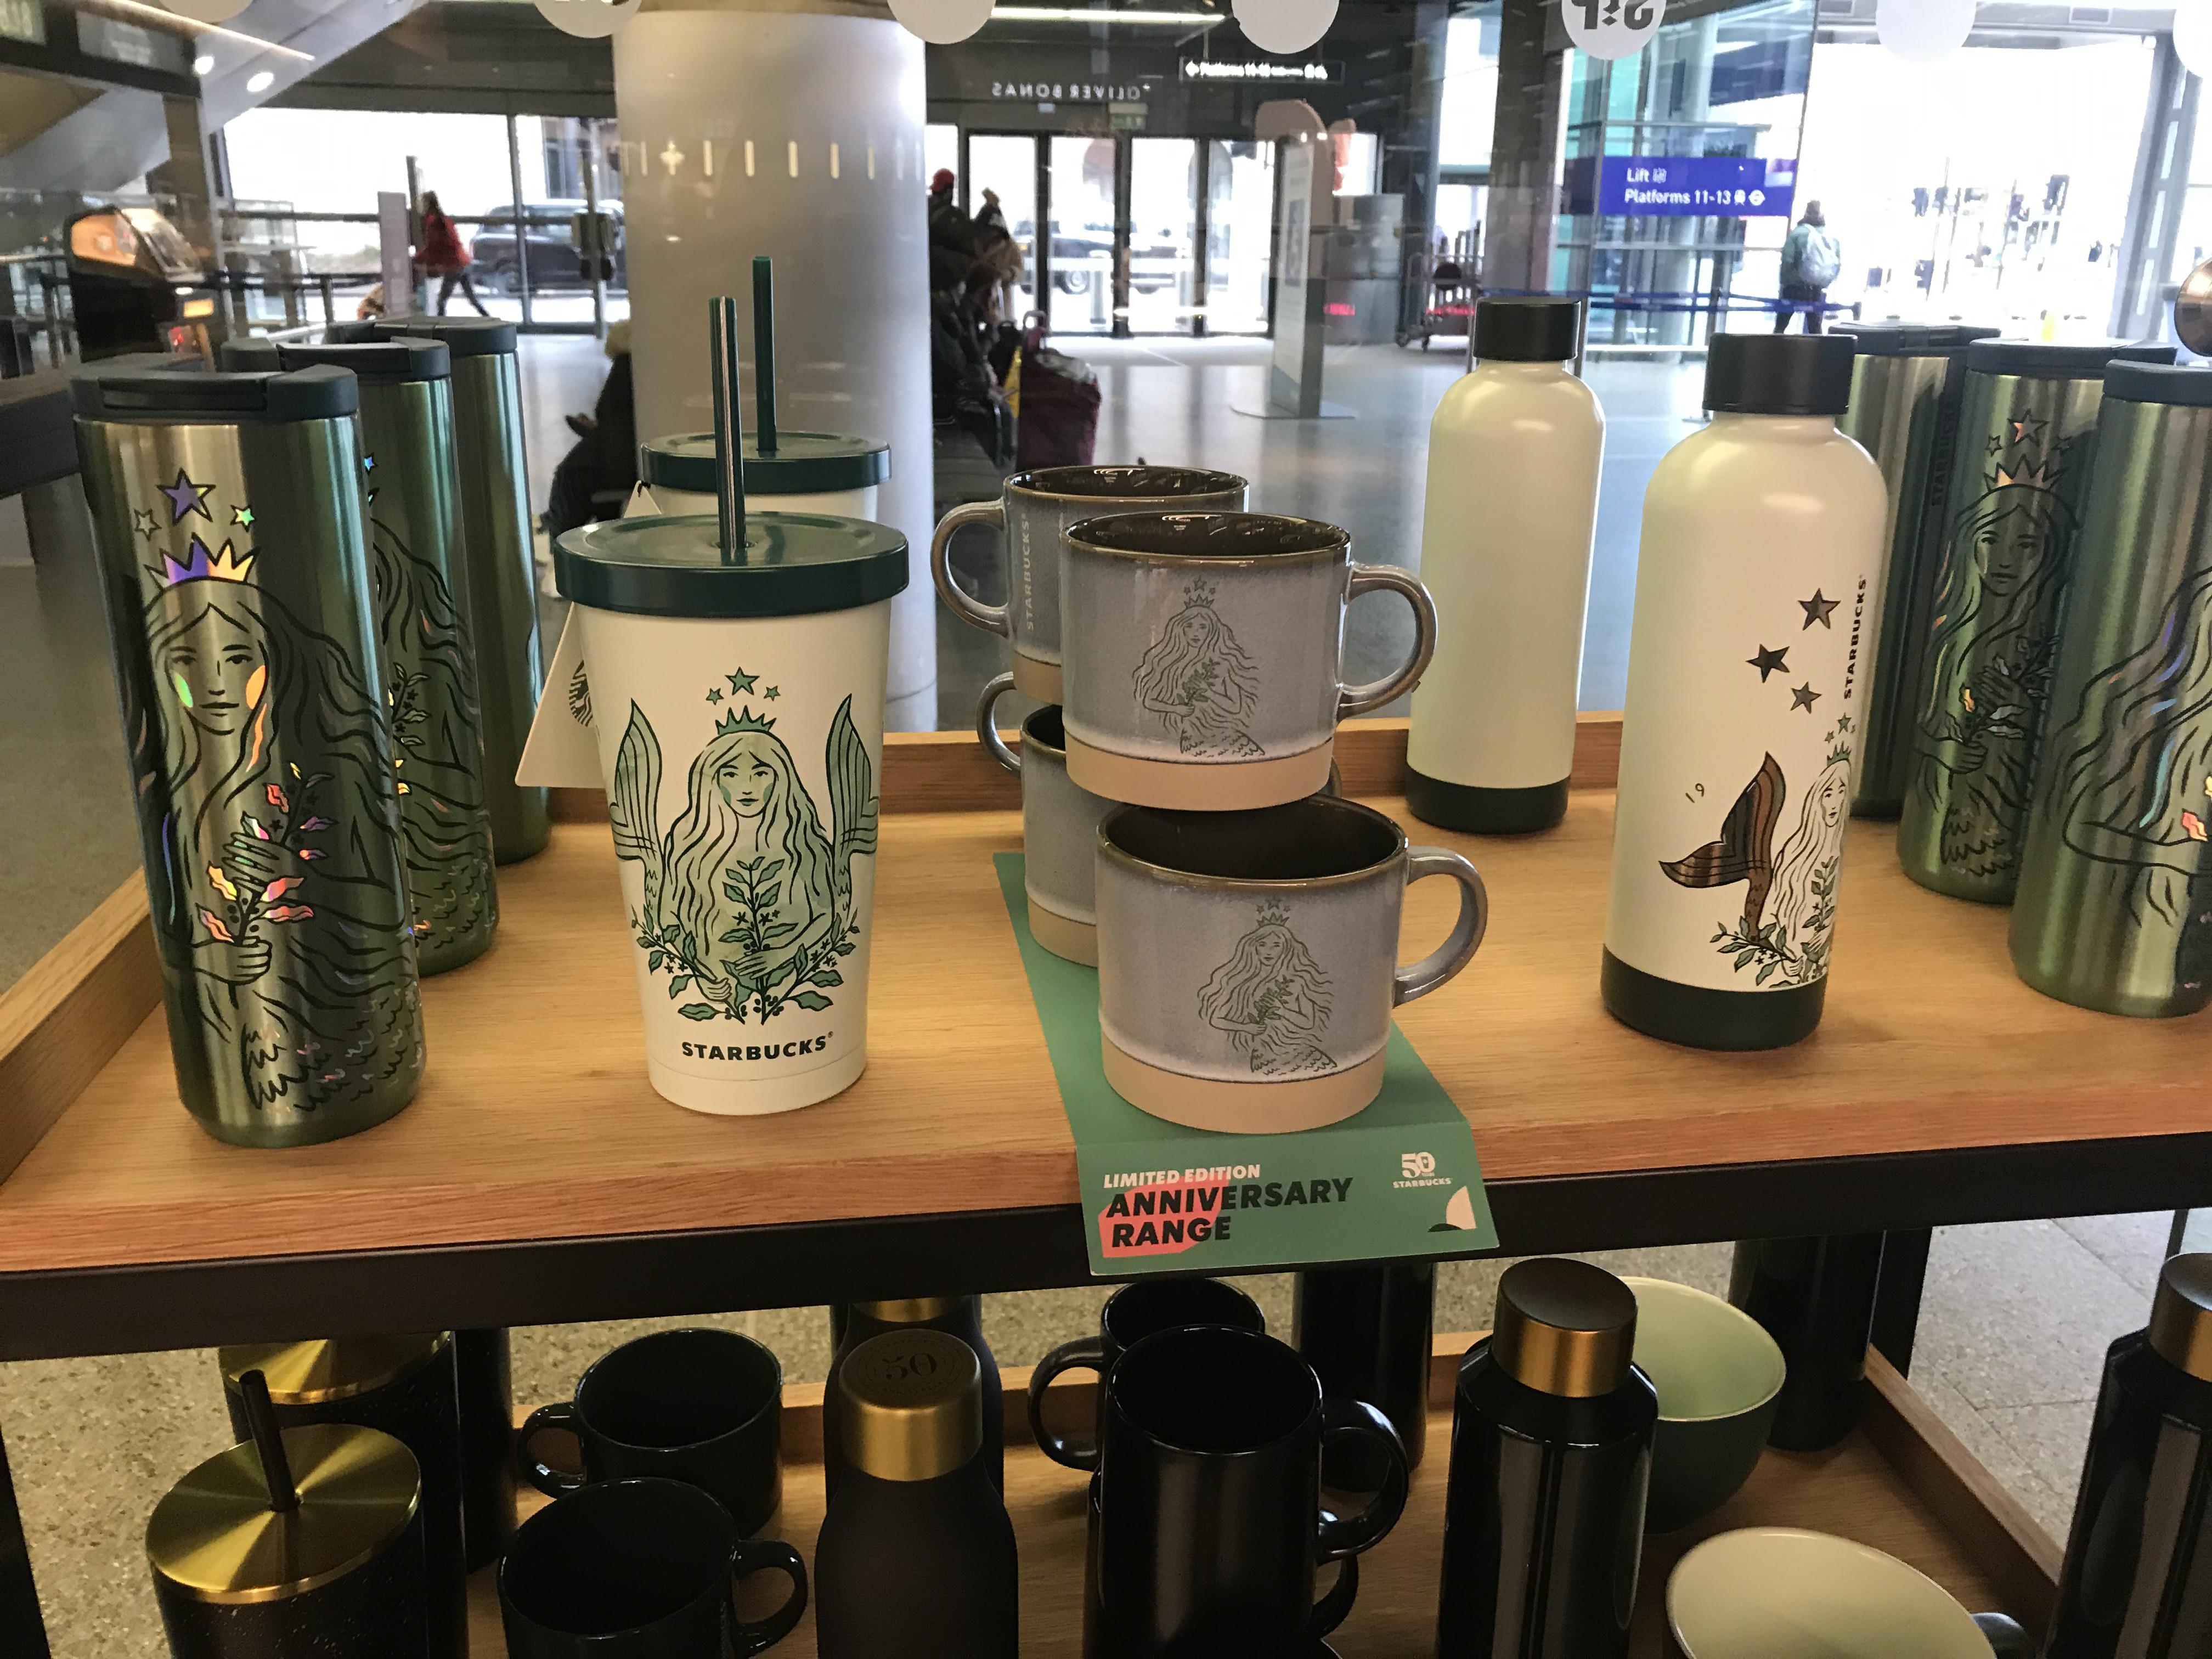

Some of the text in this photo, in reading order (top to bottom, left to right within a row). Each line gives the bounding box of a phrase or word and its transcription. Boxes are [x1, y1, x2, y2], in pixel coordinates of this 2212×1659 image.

[1627, 167, 1650, 183] Lift
[1624, 188, 1731, 205] Platforms 11-13
[1022, 521, 1034, 630] STARBUCKS
[1844, 579, 1867, 699] STARBUCKS
[1685, 783, 1705, 803] 19
[682, 1035, 826, 1060] STARBUCKS
[1103, 1164, 1261, 1189] LIMITED EDITION
[1401, 1152, 1436, 1178] 50
[1393, 1177, 1452, 1188] STARBUCKS
[1105, 1177, 1354, 1218] ANNIVERSARY
[1111, 1216, 1232, 1248] RANGE
[882, 1352, 937, 1378] 50
